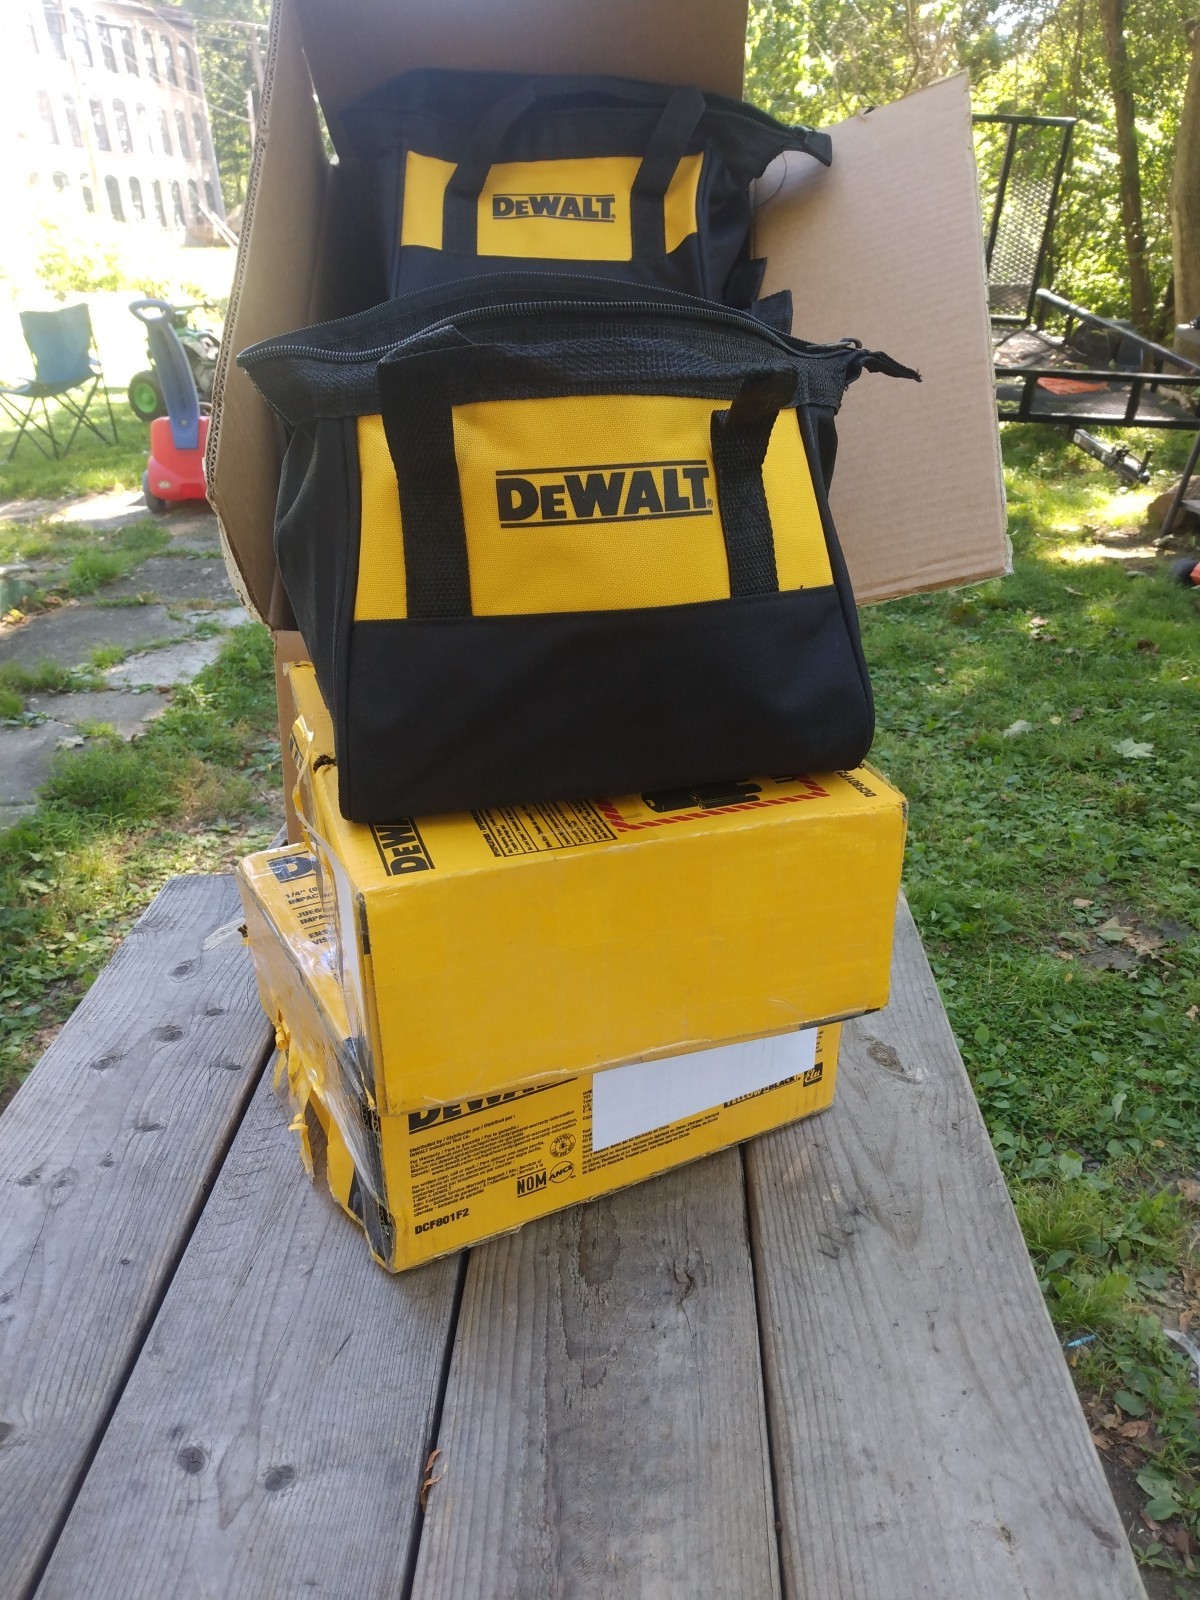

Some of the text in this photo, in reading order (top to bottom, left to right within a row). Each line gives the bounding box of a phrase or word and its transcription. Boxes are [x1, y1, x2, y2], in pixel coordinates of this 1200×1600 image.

[288, 893, 319, 905] IMPAC
[517, 1171, 547, 1195] NOM
[415, 1207, 470, 1235] DCF801F2
